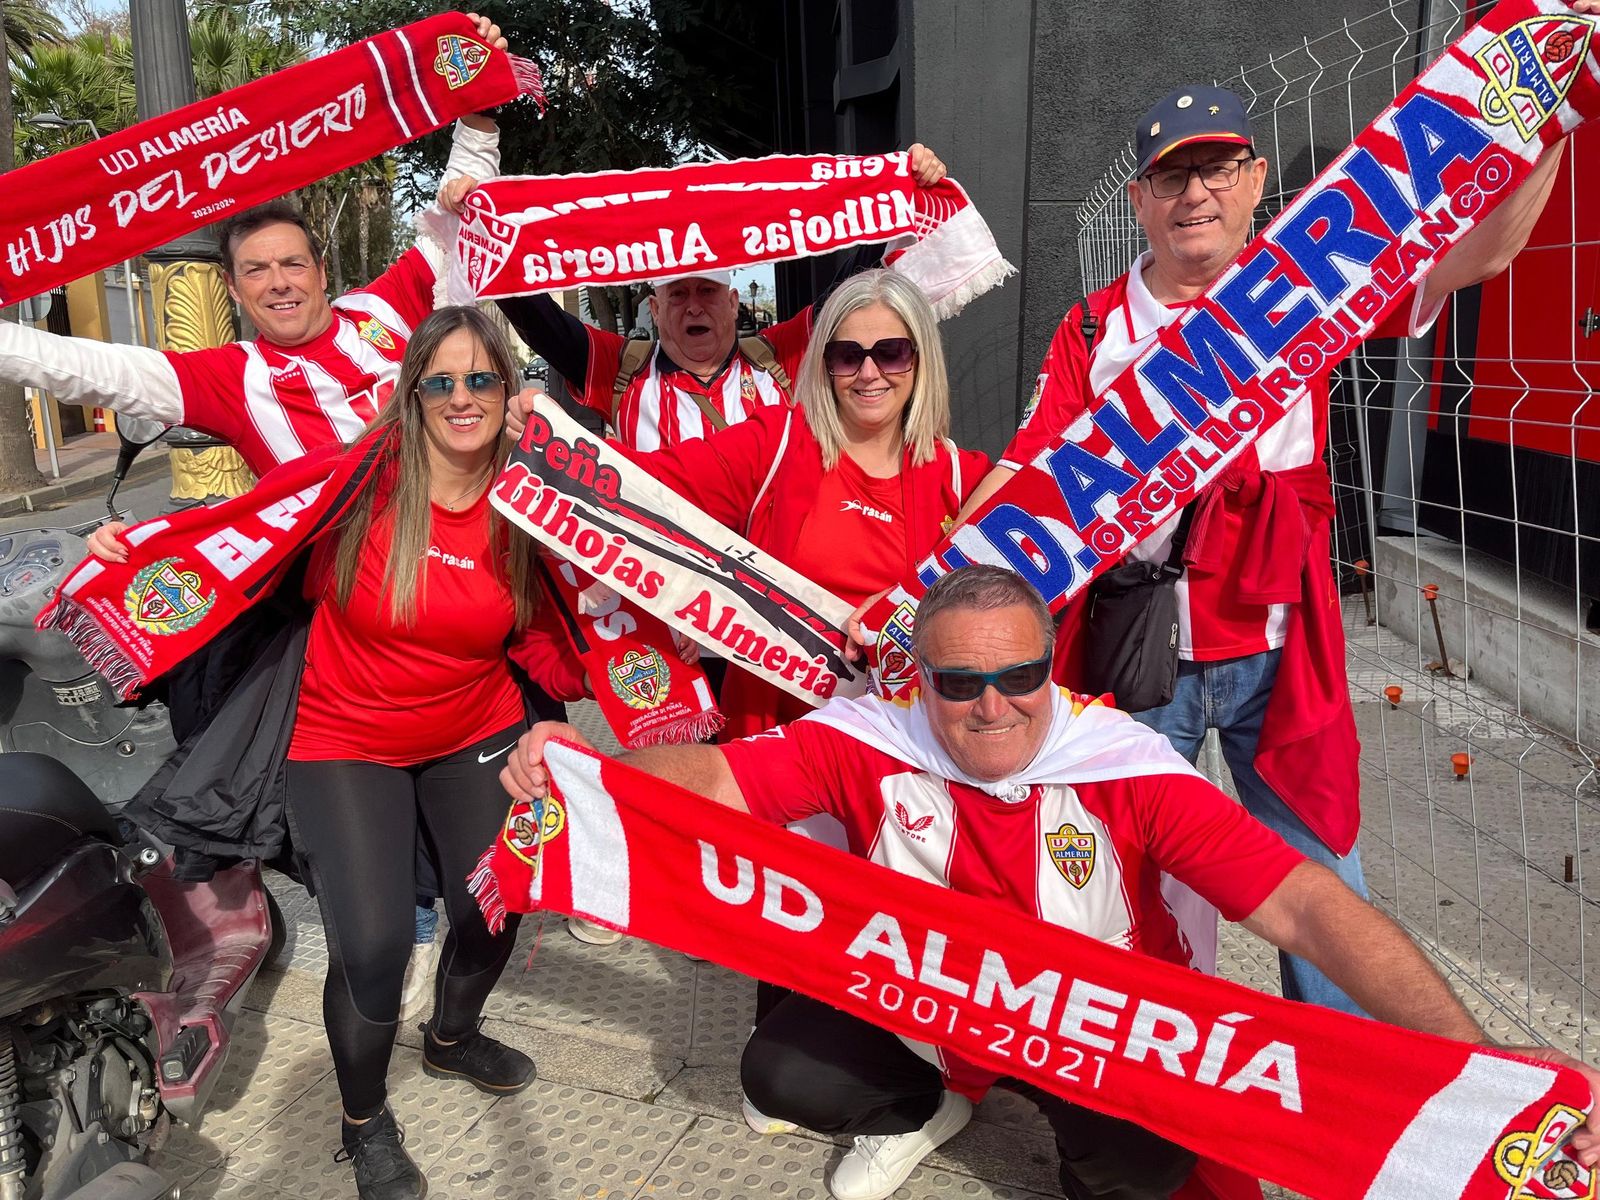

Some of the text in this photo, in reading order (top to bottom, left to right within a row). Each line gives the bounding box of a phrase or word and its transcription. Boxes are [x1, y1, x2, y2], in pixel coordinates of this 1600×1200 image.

[1512, 34, 1553, 103] ALMERIA
[99, 107, 250, 175] UD ALMERÍA
[108, 169, 198, 228] DEL
[200, 83, 367, 190] DESIERTO
[191, 198, 236, 219] 2023/2024
[1046, 92, 1494, 532] ALMERIA
[1092, 153, 1513, 555] ORGULLO ROJIBLANCO
[518, 413, 620, 500] Peña
[194, 526, 274, 581] EL
[674, 589, 838, 699] Almería
[1055, 850, 1091, 859] ALMERIA
[698, 838, 1304, 1114] UD ALMERÍA
[848, 970, 1106, 1089] 2001-2021
